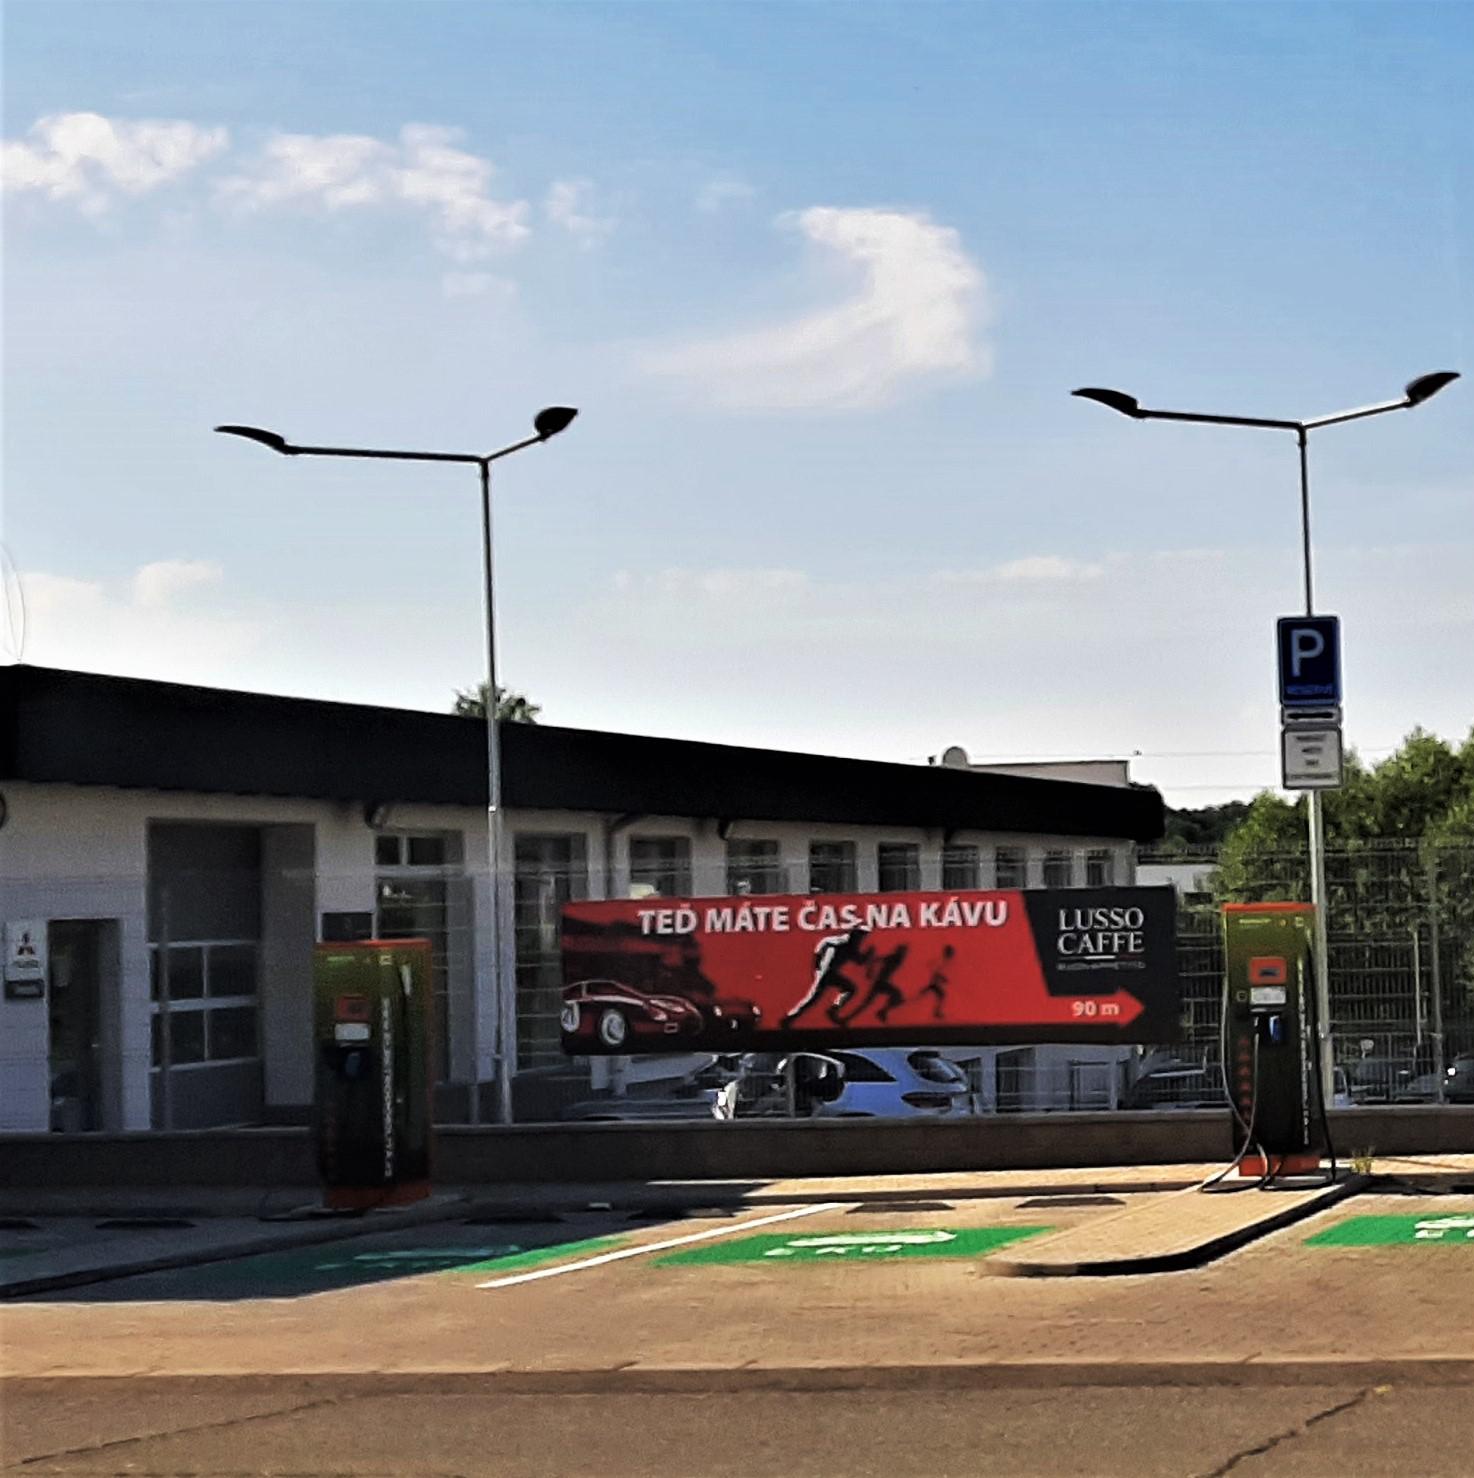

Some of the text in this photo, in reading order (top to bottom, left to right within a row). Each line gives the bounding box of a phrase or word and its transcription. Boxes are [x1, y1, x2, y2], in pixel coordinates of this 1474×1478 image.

[1290, 628, 1325, 678] P
[637, 897, 1008, 935] TEĎ MÁTE ČAS NA KÁVU
[1058, 907, 1145, 931] LUSSO
[1056, 931, 1145, 954] CAFFE
[1071, 1000, 1120, 1017] 90 m
